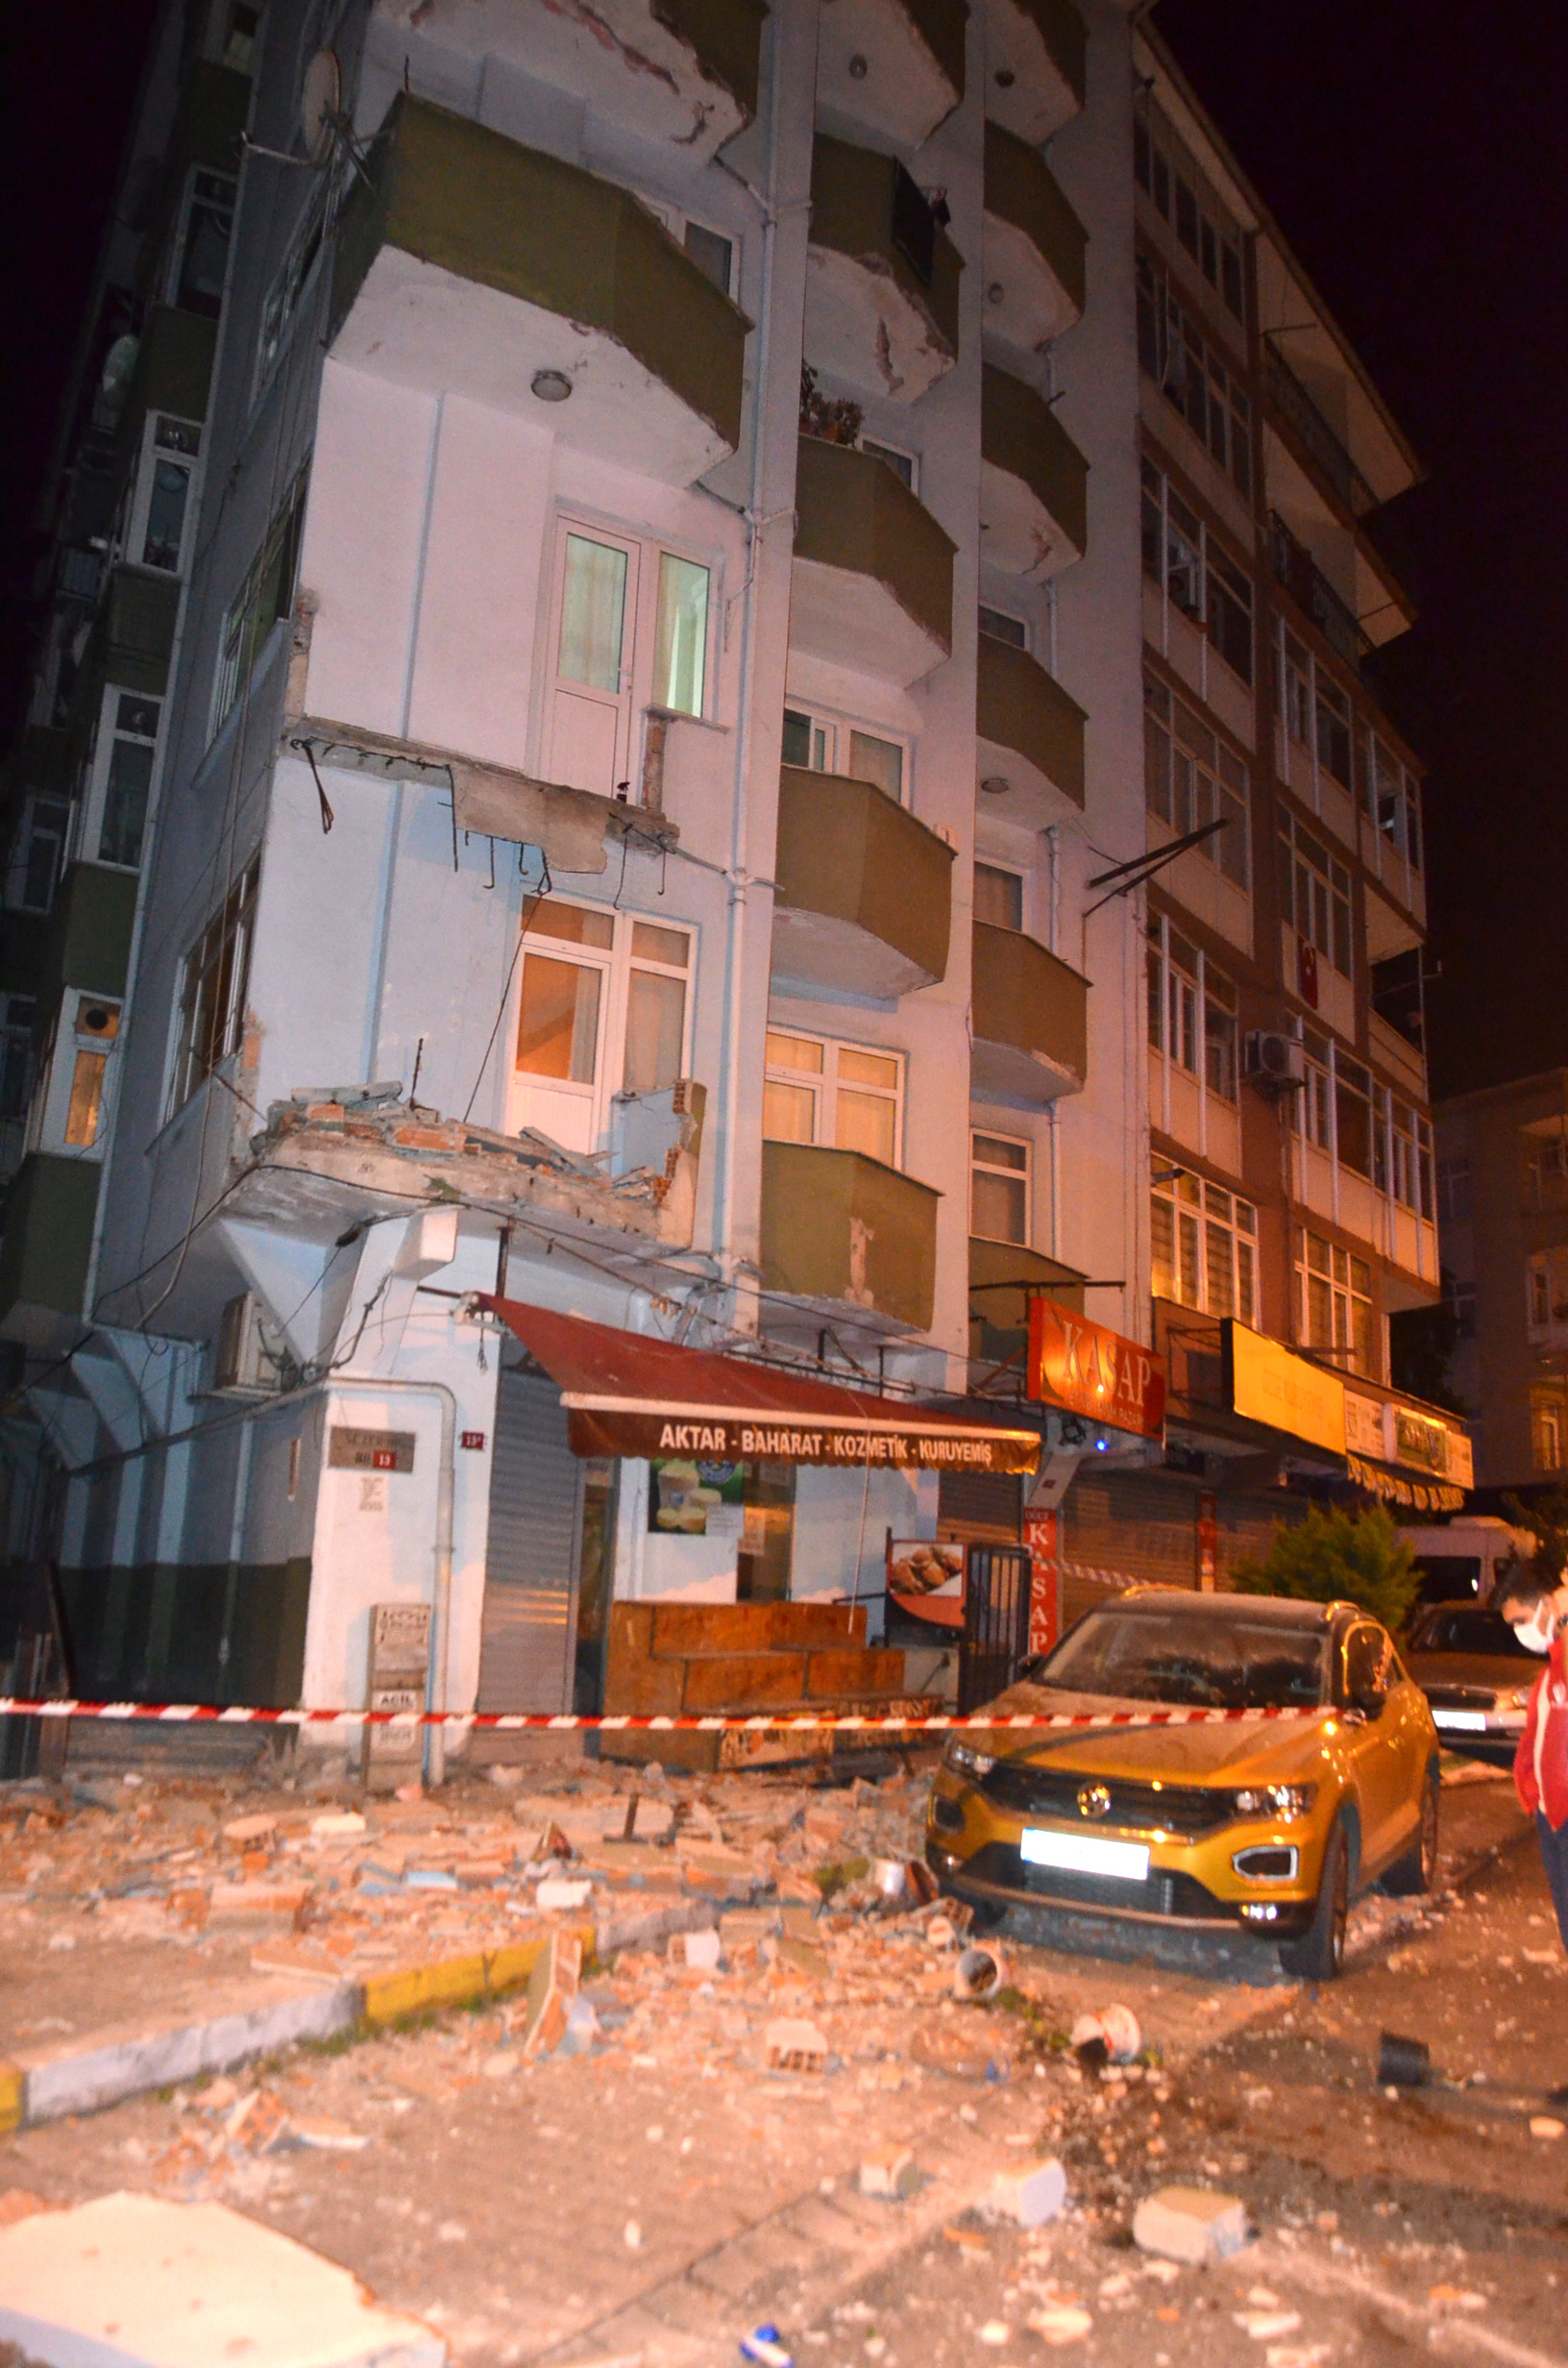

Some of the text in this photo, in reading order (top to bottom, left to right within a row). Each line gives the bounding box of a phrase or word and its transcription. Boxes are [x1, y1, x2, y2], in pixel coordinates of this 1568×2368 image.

[1064, 1320, 1151, 1407] KASAP
[659, 1423, 726, 1451] AKTAR
[742, 1429, 823, 1457] BAHARAT
[834, 1434, 908, 1459] KOZMETİK
[919, 1440, 992, 1468] KURUYEMİŞ
